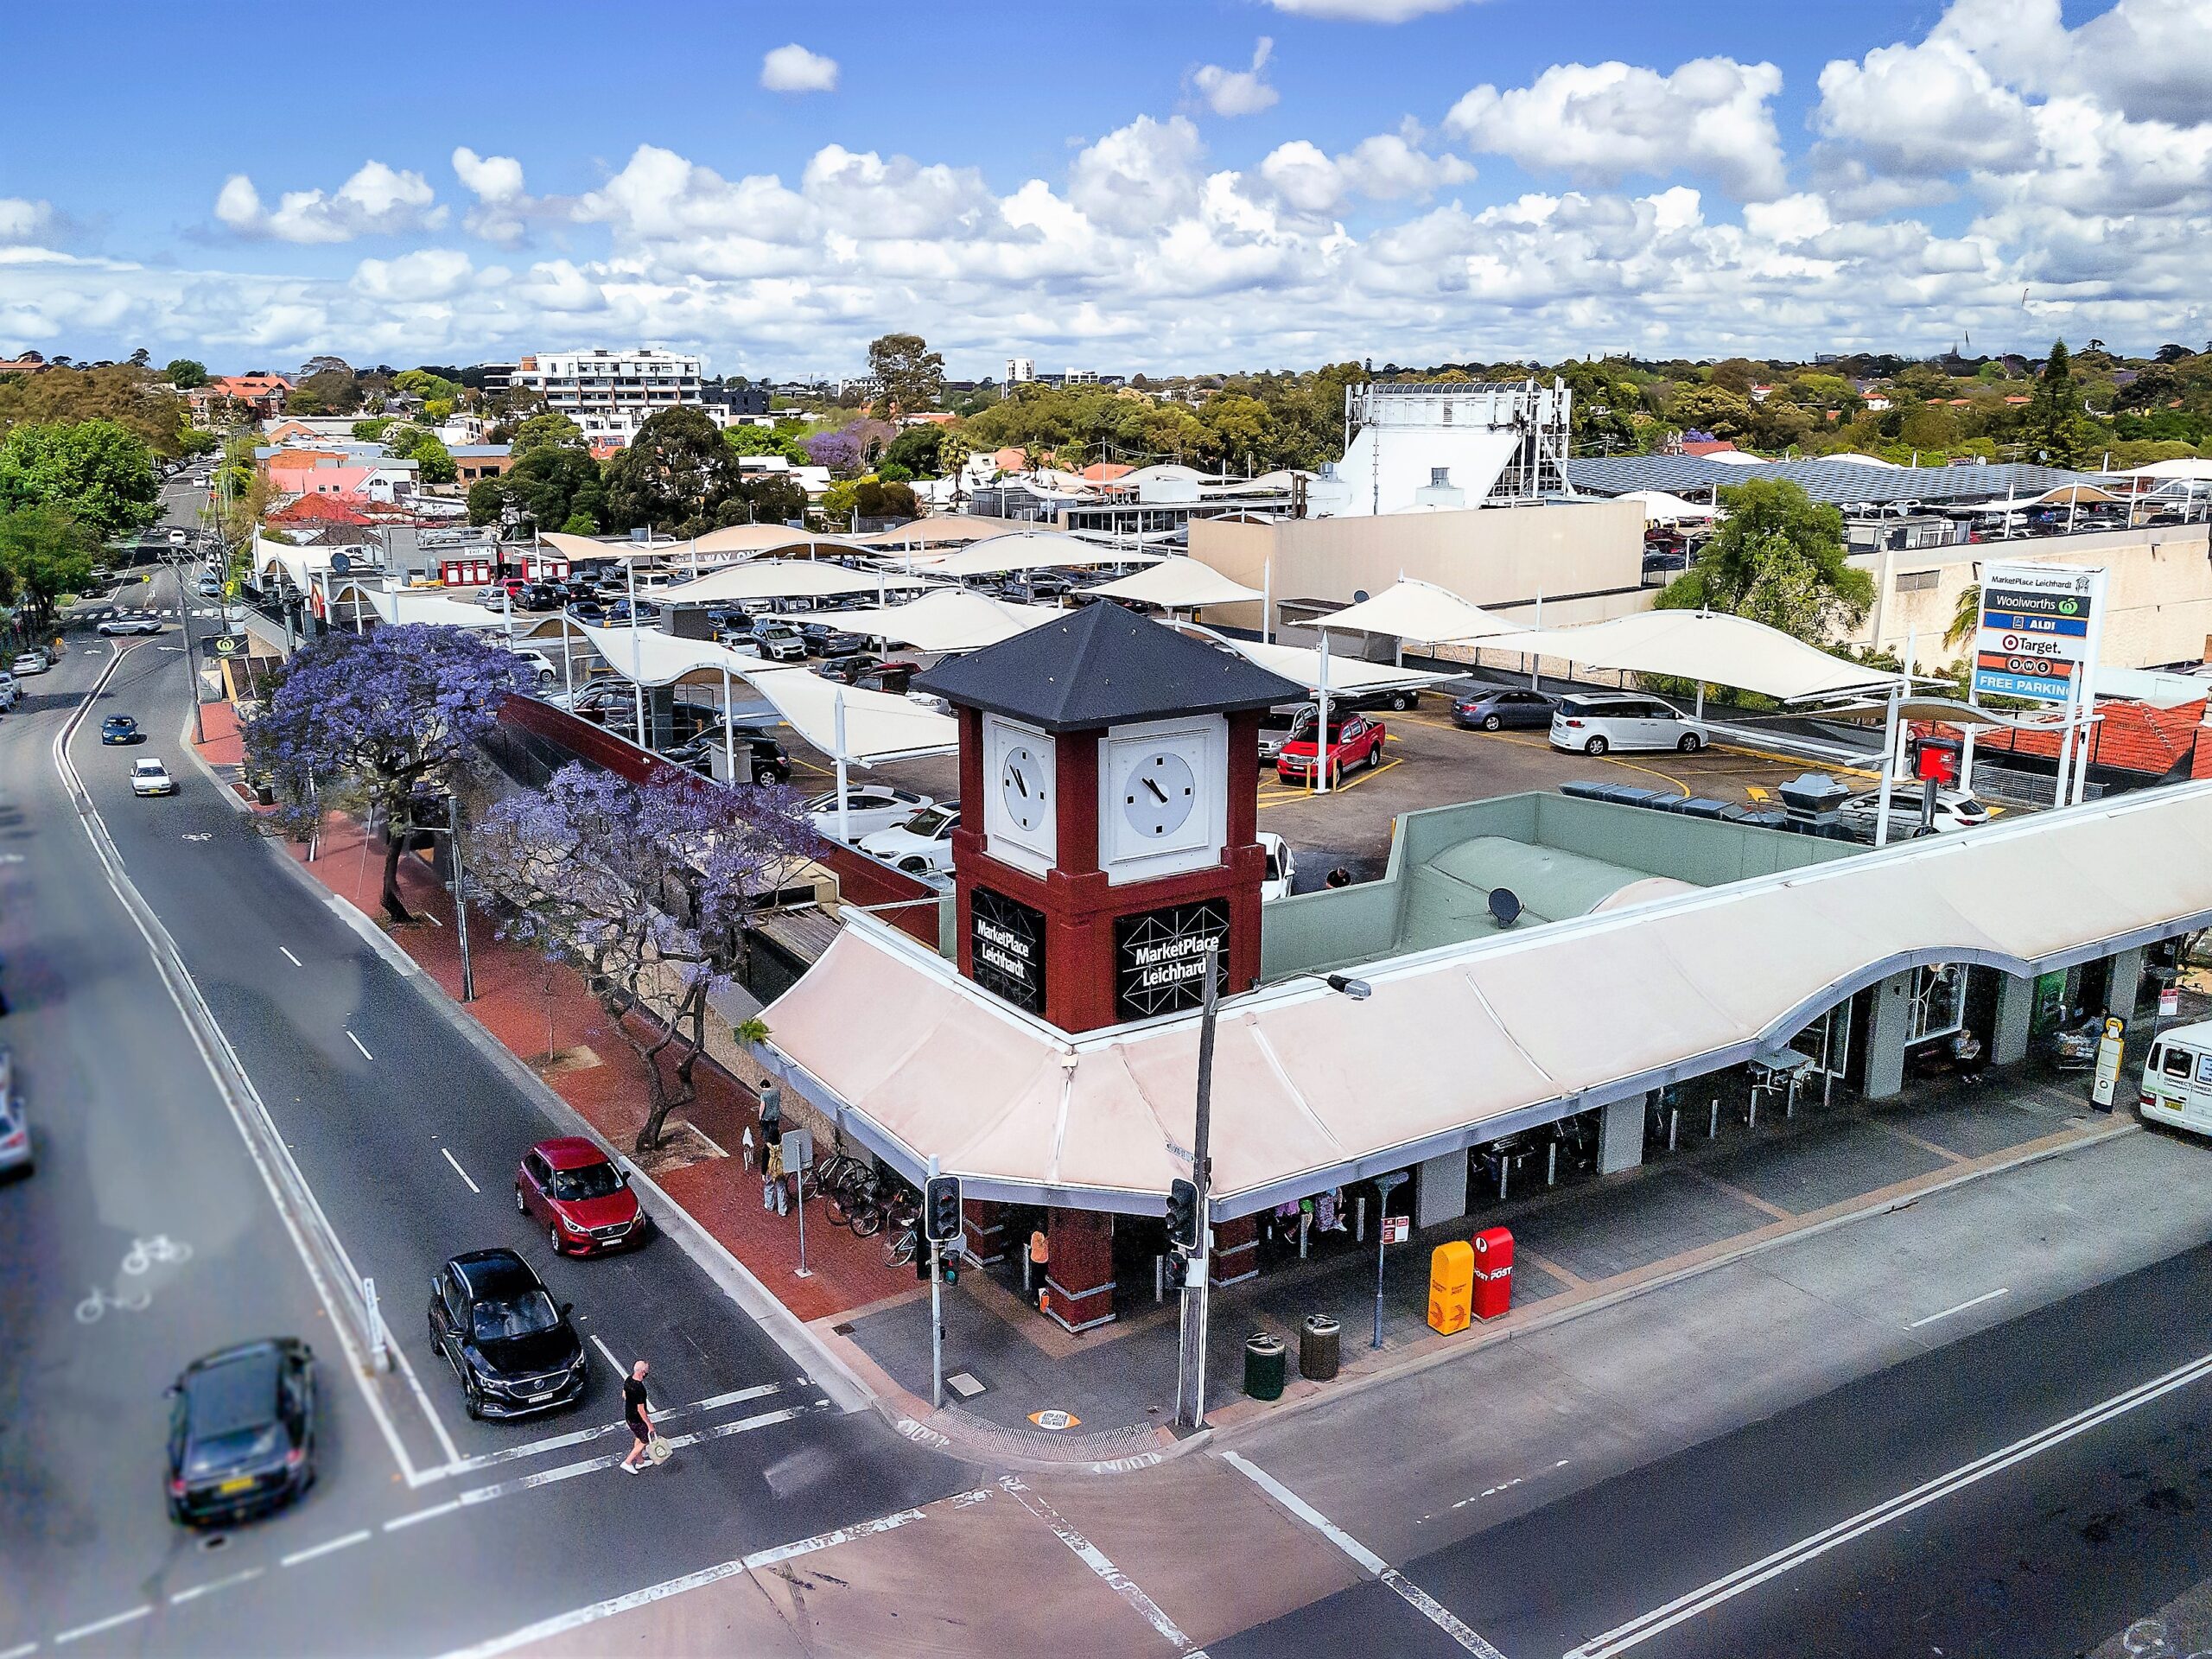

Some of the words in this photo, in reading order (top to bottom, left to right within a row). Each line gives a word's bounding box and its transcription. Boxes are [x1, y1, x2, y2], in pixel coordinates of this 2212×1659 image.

[1992, 576, 2034, 586] MarketPlace
[2035, 578, 2072, 588] Leichhardt
[1996, 595, 2056, 610] Woolworths
[2029, 620, 2056, 631] ALDI
[1980, 677, 2012, 689] FREE
[2017, 681, 2069, 695] PARKIN
[977, 919, 1029, 957] MarketPlace
[1135, 936, 1219, 965] MarketPlace
[982, 944, 1025, 978] Leichhardt
[1142, 958, 1206, 986] Leichhard
[1491, 1267, 1512, 1281] POST
